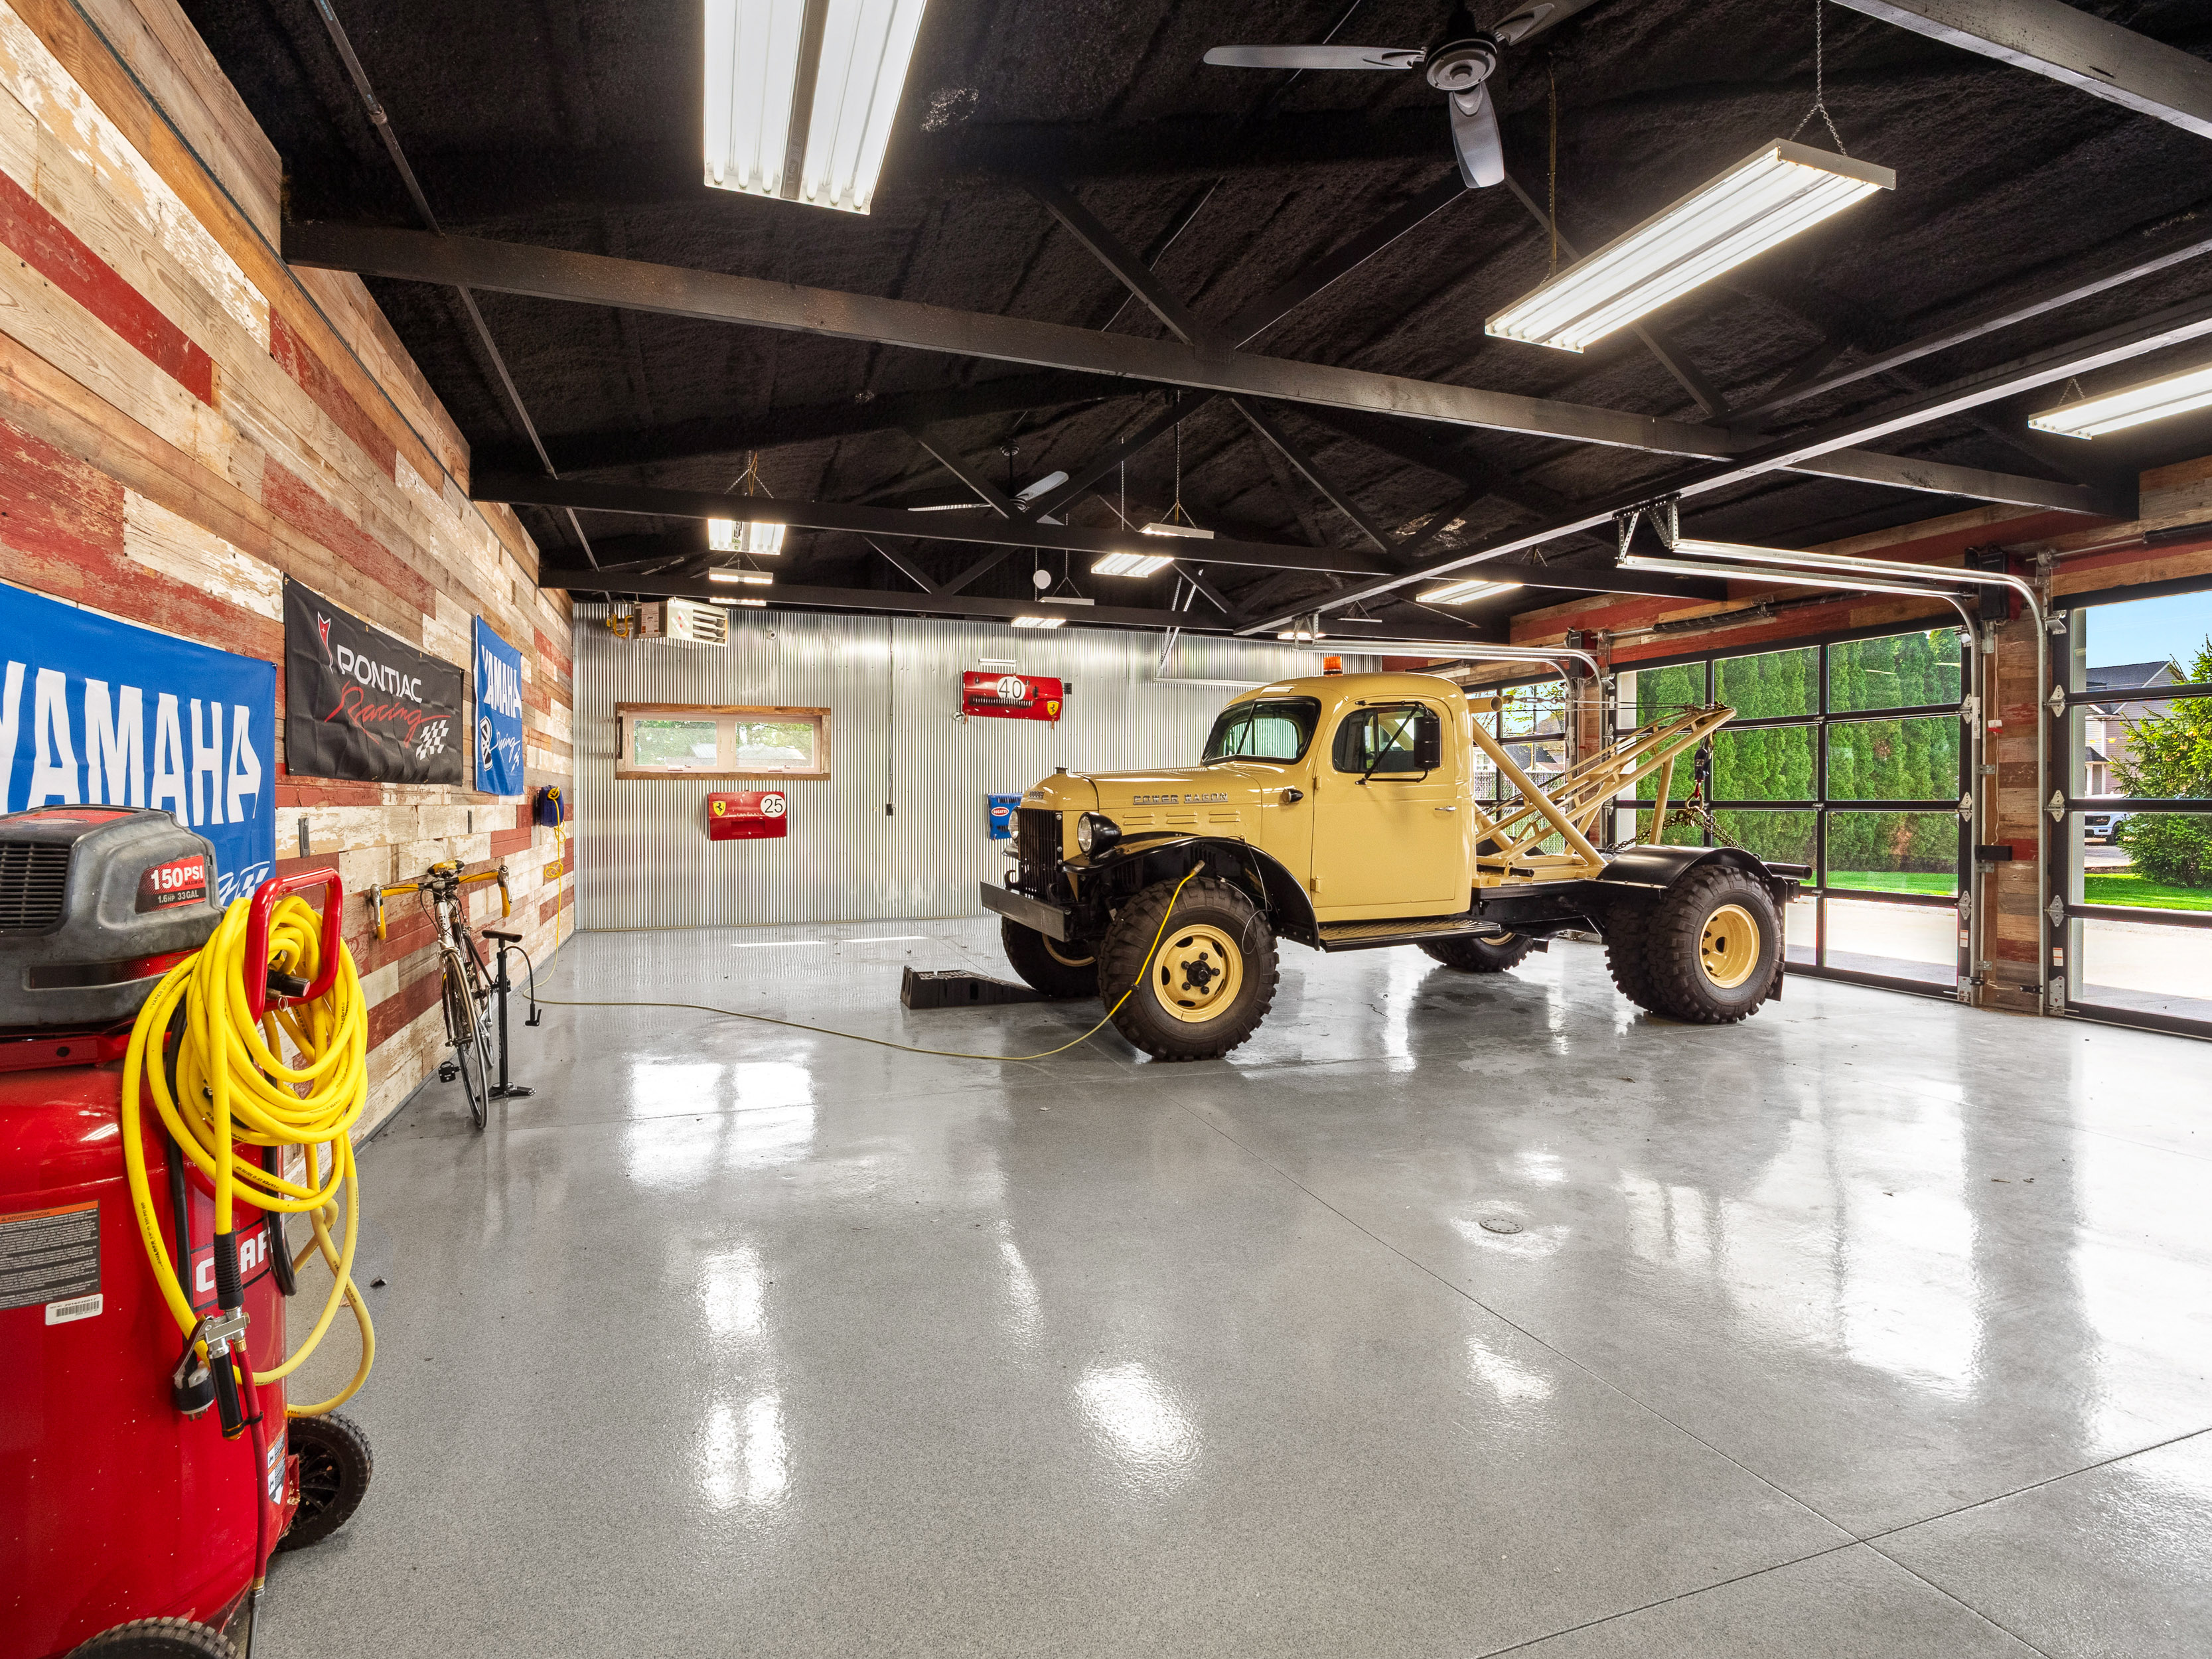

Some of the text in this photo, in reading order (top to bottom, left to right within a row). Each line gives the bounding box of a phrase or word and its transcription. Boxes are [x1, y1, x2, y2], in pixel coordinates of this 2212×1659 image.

[337, 644, 423, 704] PONTIAC
[480, 644, 522, 719] YAMAHA
[998, 678, 1022, 699] 40
[324, 680, 452, 749] Racing
[764, 798, 783, 814] 25
[1133, 792, 1228, 804] POWER WAGON
[7, 1211, 51, 1222] ADVERTENCIA
